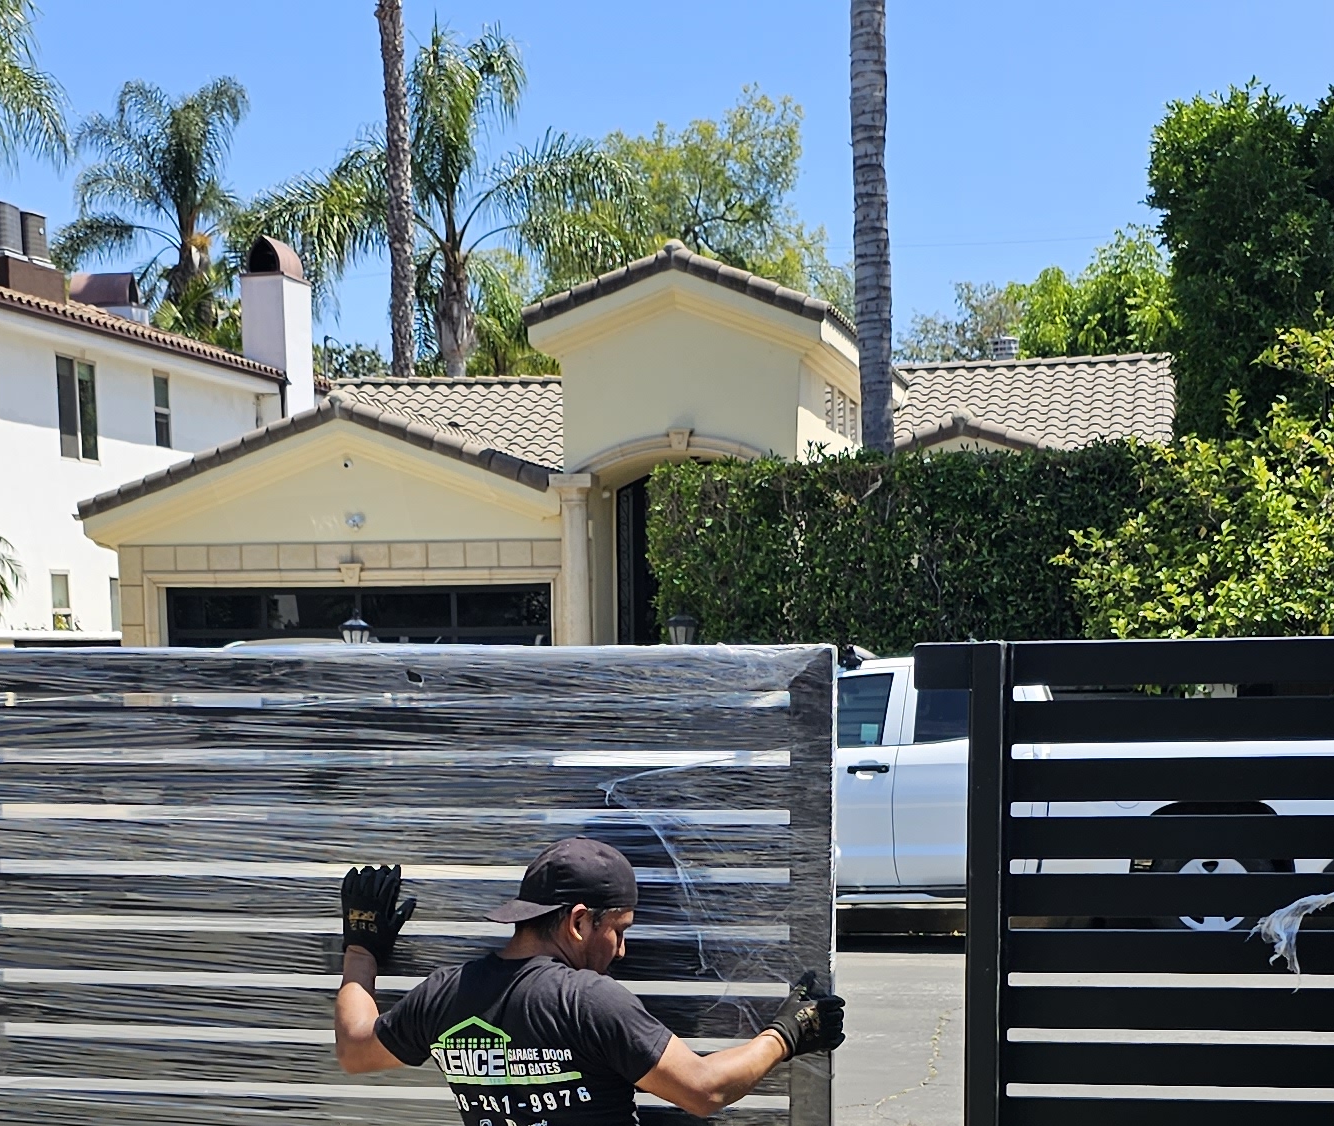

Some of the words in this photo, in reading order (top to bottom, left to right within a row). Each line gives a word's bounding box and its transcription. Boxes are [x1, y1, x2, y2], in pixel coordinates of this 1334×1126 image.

[508, 1048, 540, 1061] GARAGE
[542, 1048, 573, 1061] DOOR
[509, 1063, 526, 1075] AND
[528, 1062, 561, 1075] GATES
